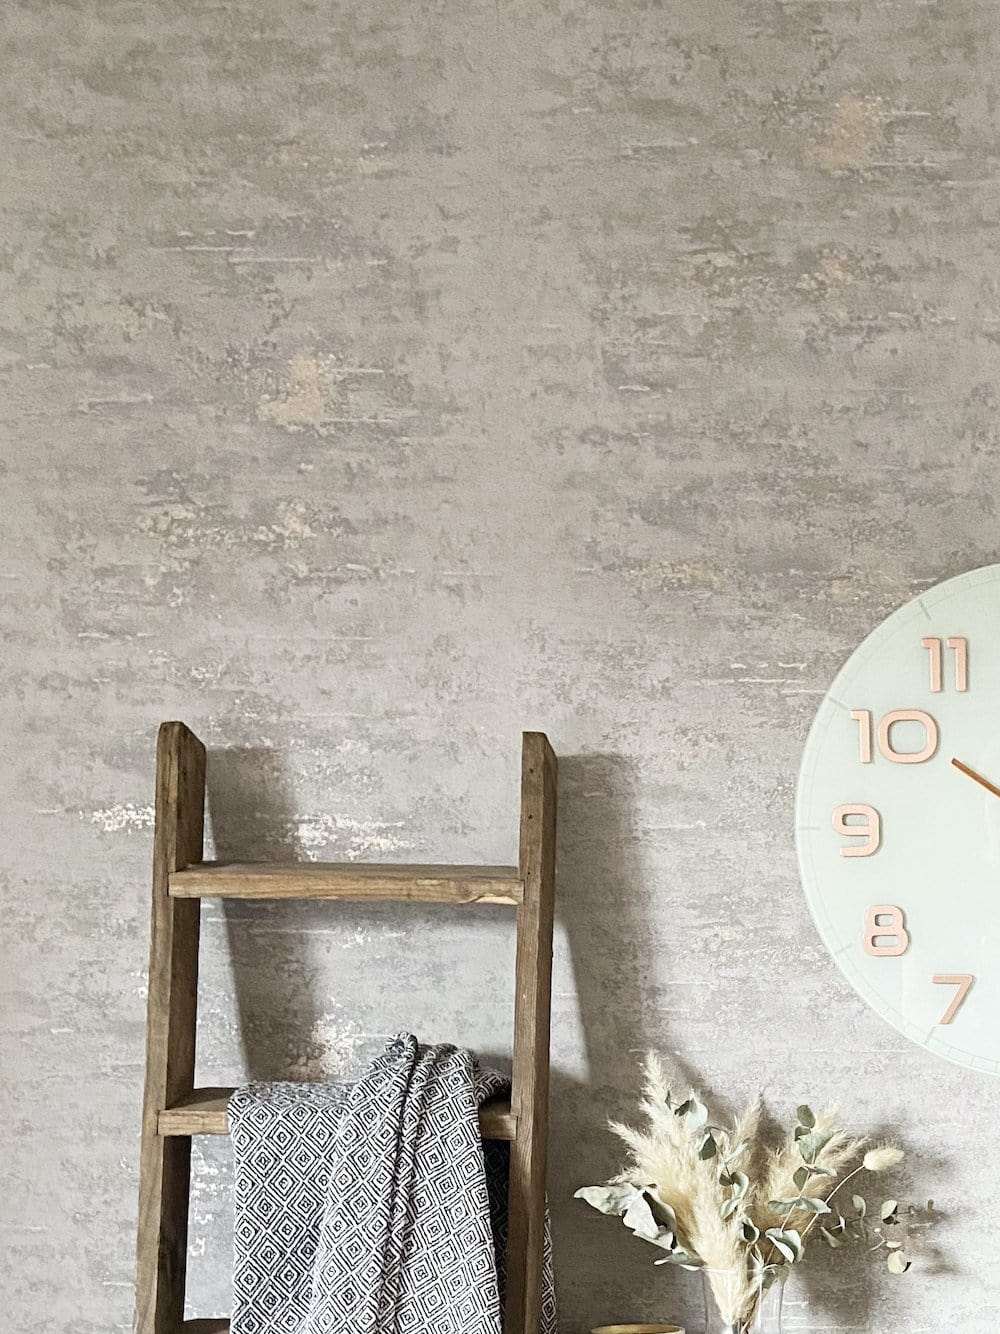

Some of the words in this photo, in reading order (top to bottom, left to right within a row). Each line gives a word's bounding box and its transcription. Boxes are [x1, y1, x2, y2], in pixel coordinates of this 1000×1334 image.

[922, 637, 968, 692] 11
[850, 709, 938, 763] 10
[832, 804, 881, 857] 9
[862, 905, 910, 957] 8
[932, 974, 975, 1024] 7
